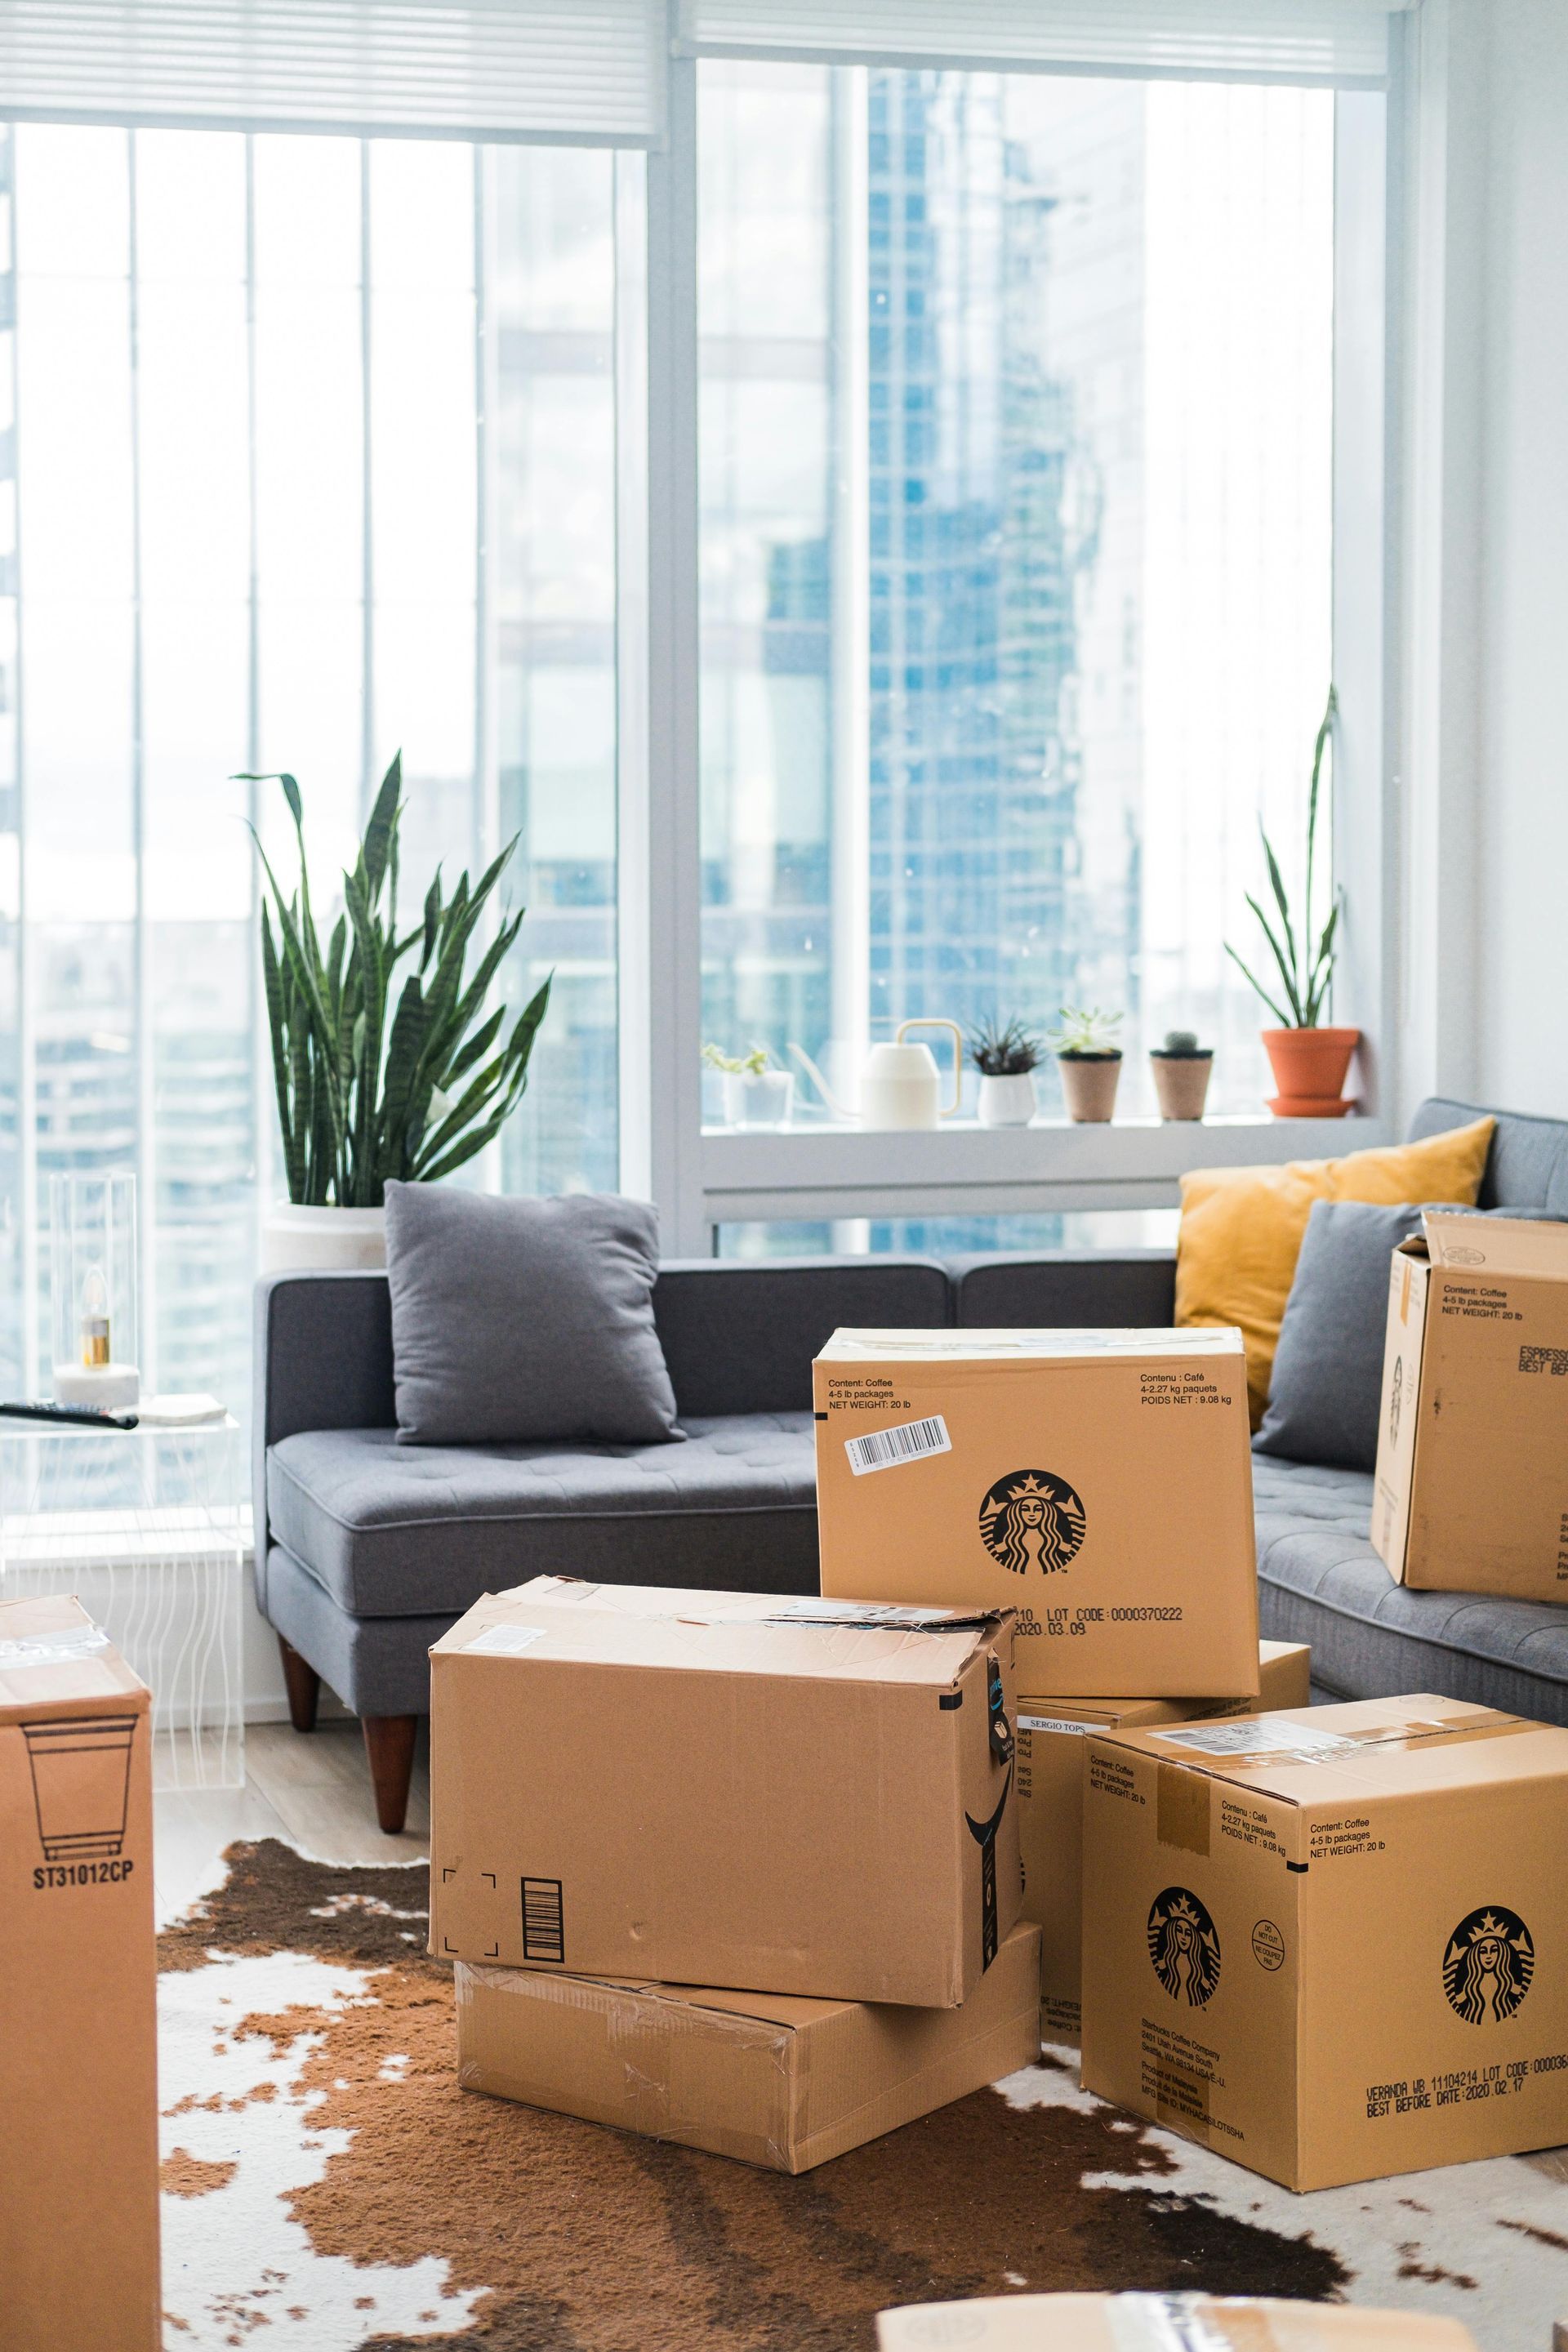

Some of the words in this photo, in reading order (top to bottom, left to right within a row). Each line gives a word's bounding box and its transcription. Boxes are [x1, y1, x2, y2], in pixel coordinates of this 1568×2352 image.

[1443, 1285, 1478, 1295] Content:
[1480, 1288, 1507, 1298] Coffee
[1442, 1296, 1456, 1304] 4-5
[1468, 1298, 1508, 1309] packages
[1441, 1307, 1460, 1315] NET
[1463, 1308, 1500, 1318] WEIGHT:
[1502, 1312, 1513, 1320] 20
[1514, 1312, 1522, 1321] lb
[1518, 1359, 1545, 1374] BEST
[828, 1379, 863, 1387] Content:
[866, 1379, 893, 1387] Coffee
[1140, 1374, 1176, 1383] Contenu
[1184, 1373, 1205, 1382] Café
[854, 1390, 893, 1399] packages
[1141, 1385, 1168, 1393] 4-2.27
[1170, 1385, 1181, 1394] kg
[1183, 1385, 1218, 1394] paquets
[829, 1401, 848, 1410] NET
[850, 1401, 889, 1409] WEIGHT:
[890, 1401, 901, 1409] 20
[903, 1401, 911, 1409] lb
[1141, 1396, 1171, 1405] POIDS
[1174, 1396, 1192, 1404] NET
[1200, 1396, 1219, 1404] 9.08
[1221, 1396, 1232, 1405] kg
[1047, 1608, 1069, 1621] LOT
[1014, 1623, 1085, 1635] 2020.03.09
[1031, 1720, 1062, 1731] SERGIO
[1063, 1723, 1085, 1734] TOPS
[1090, 1755, 1114, 1771] Content:
[1116, 1764, 1134, 1777] Coffee
[1091, 1767, 1100, 1777] 4-5
[1101, 1771, 1107, 1779] lb
[1107, 1775, 1134, 1788] packages
[1090, 1778, 1102, 1789] NET
[1103, 1783, 1130, 1799] WEIGHT:
[1131, 1793, 1139, 1802] 20
[1140, 1796, 1146, 1805] lb
[1222, 1800, 1248, 1817] Contenu
[1252, 1811, 1267, 1824] Café
[1221, 1813, 1241, 1826] 4-2.27
[1242, 1819, 1250, 1832] kg
[1251, 1824, 1276, 1839] paquets
[1310, 1823, 1343, 1833] Content:
[1344, 1819, 1370, 1829] Coffee
[1222, 1824, 1243, 1840] POIDS
[1244, 1832, 1258, 1845] NET
[1263, 1839, 1277, 1852] 9.08
[1278, 1844, 1286, 1858] kg
[1310, 1836, 1323, 1846] 4-5
[1325, 1834, 1333, 1844] lb
[1334, 1831, 1370, 1845] packages
[1310, 1848, 1328, 1859] NET
[1330, 1843, 1365, 1856] WEIGHT:
[1366, 1842, 1377, 1851] 20
[1379, 1841, 1386, 1850] lb
[33, 1860, 134, 1889] ST31012CP
[1264, 1925, 1272, 1933] DO
[1258, 1931, 1268, 1940] NOT
[1268, 1936, 1278, 1944] CUT
[1142, 2018, 1170, 2038] Starbucks
[1171, 2031, 1191, 2047] Coffee
[1192, 2040, 1220, 2062] Company
[1142, 2030, 1156, 2042] 2401
[1157, 2038, 1171, 2051] Utah
[1172, 2044, 1194, 2061] Avenue
[1195, 2055, 1213, 2069] South
[1165, 2051, 1176, 2065] WA
[1142, 2060, 1165, 2078] Product
[1165, 2072, 1171, 2080] of
[1366, 2082, 1407, 2102] VERANDA
[1413, 2078, 1425, 2095] WB
[1431, 2070, 1477, 2091] 11104214
[1483, 2065, 1501, 2082] LOT
[1142, 2085, 1156, 2099] MFG
[1366, 2100, 1391, 2118] BEST
[1396, 2092, 1432, 2114] BEFORE
